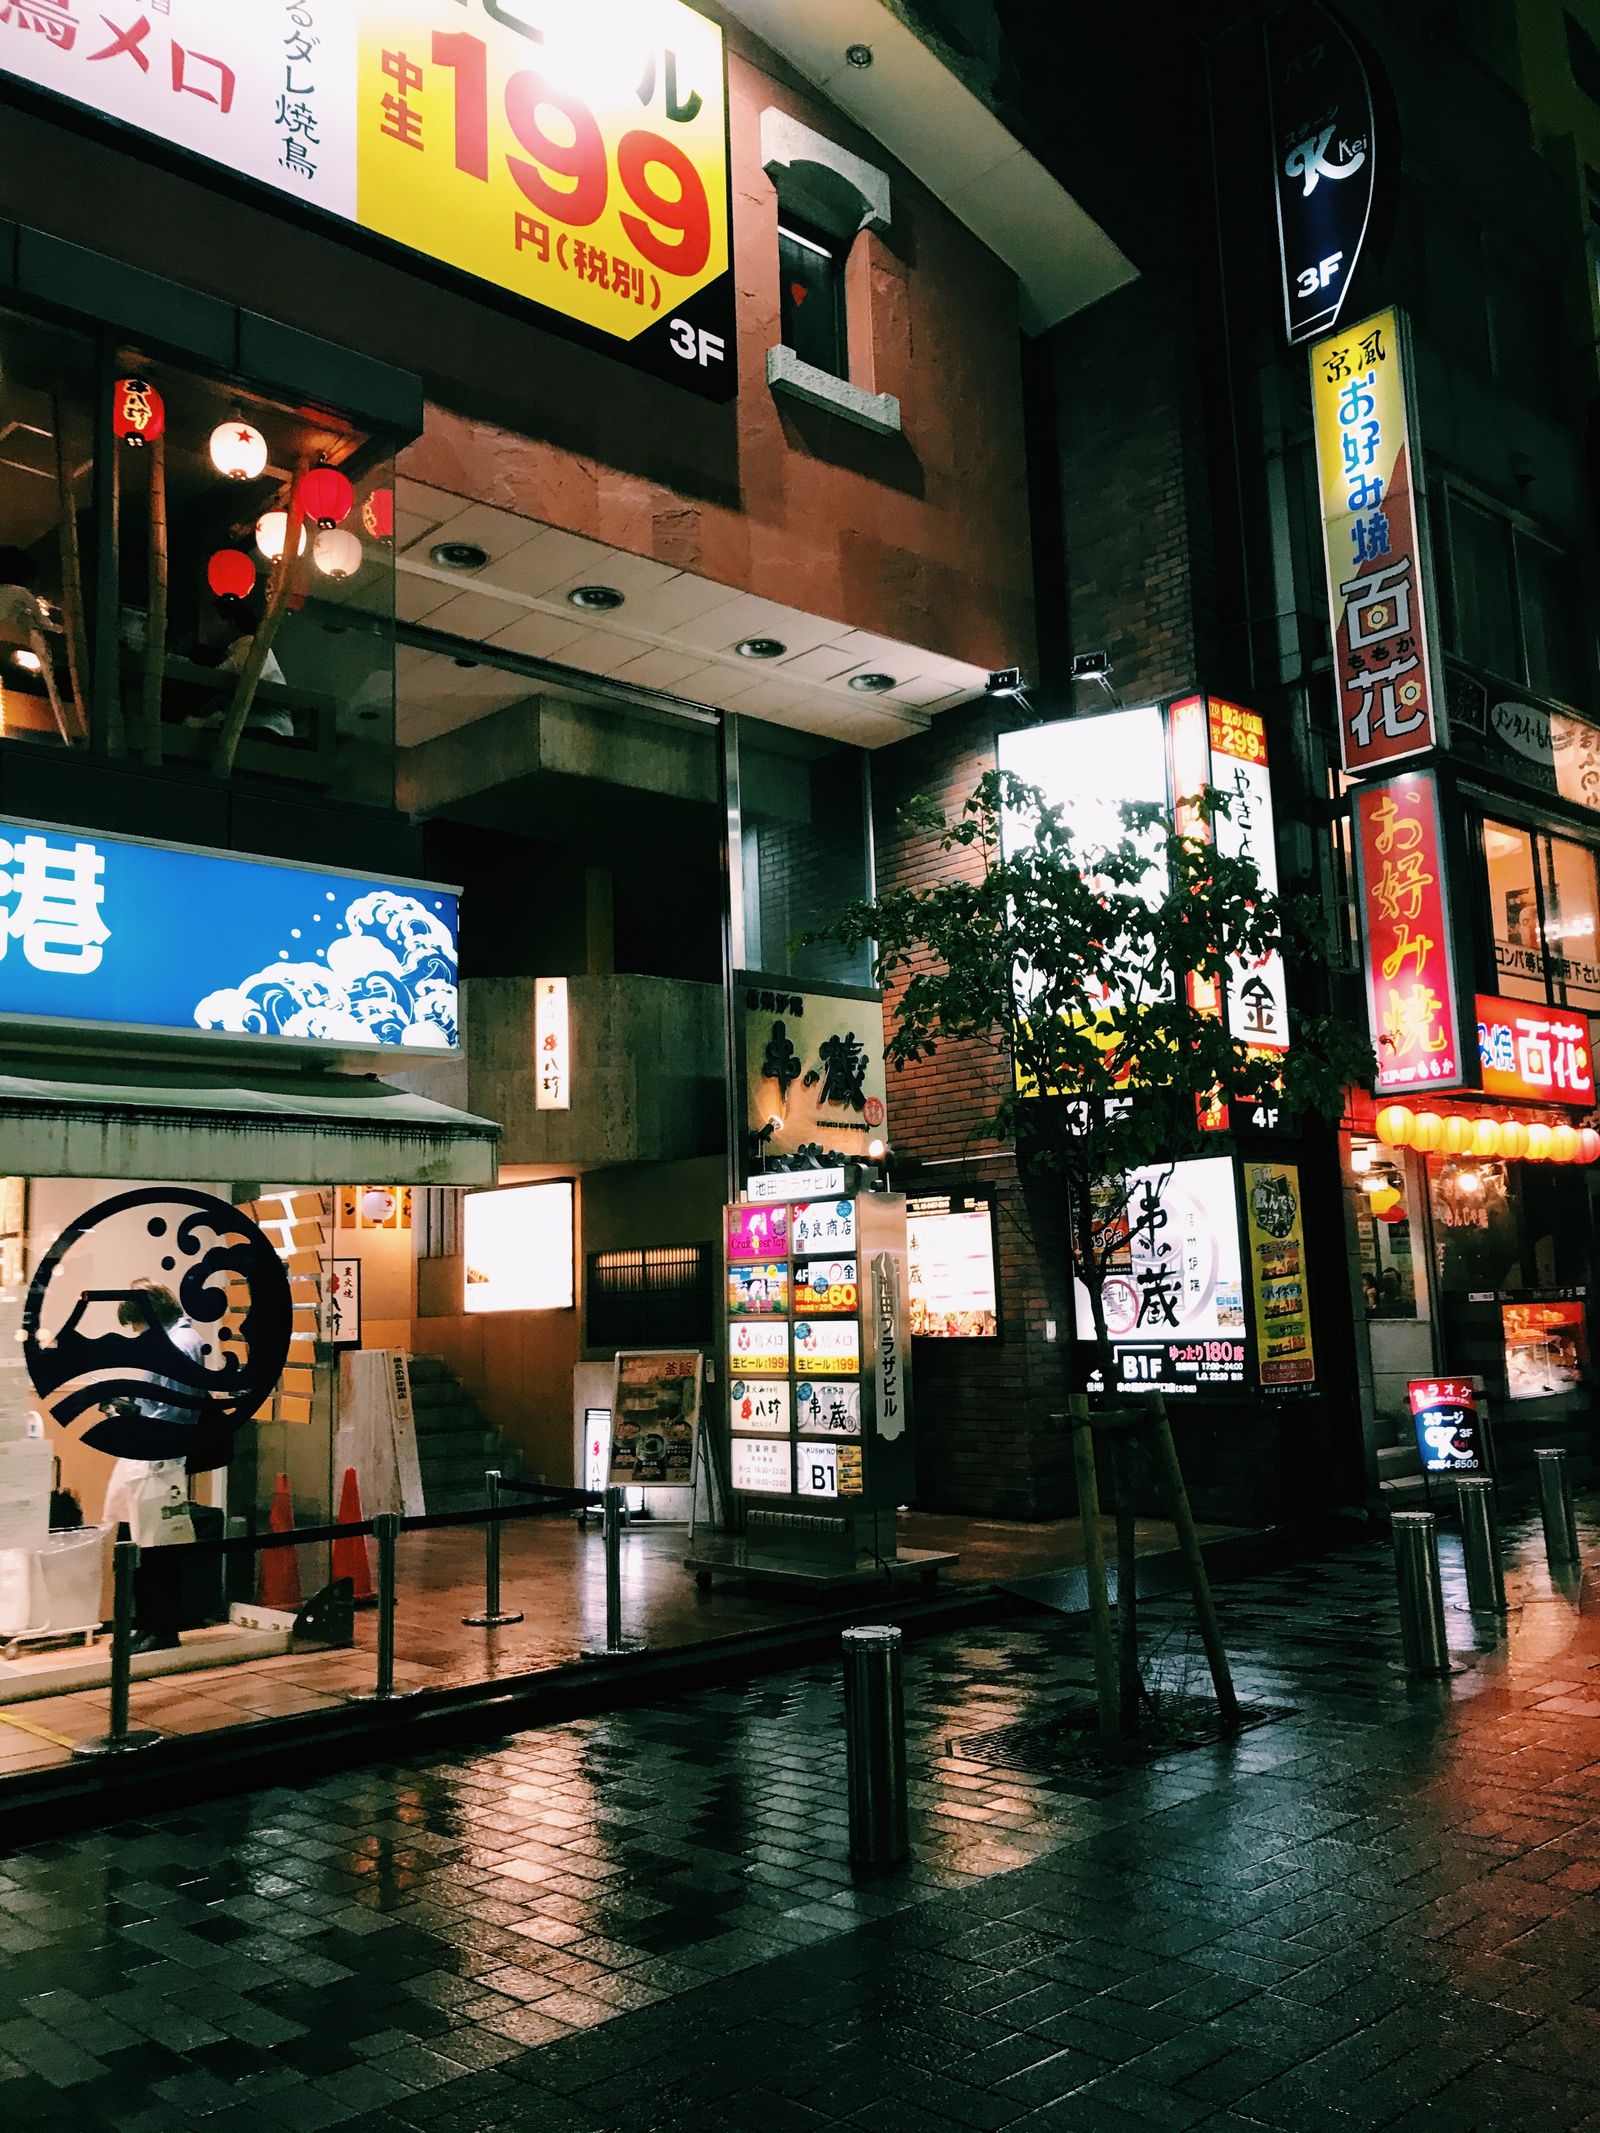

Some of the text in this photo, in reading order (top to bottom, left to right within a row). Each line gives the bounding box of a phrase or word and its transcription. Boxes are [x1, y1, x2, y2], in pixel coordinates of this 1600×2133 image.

[379, 48, 424, 152] 中生
[431, 29, 711, 278] 199
[1338, 134, 1368, 162] Kei
[1296, 250, 1343, 298] 3F
[669, 318, 725, 367] 3F
[1322, 328, 1386, 384] 京風
[1338, 368, 1393, 567] お好み焼
[1340, 555, 1425, 747] 百花
[1347, 636, 1417, 670] ももか
[1232, 766, 1256, 866] やきと
[0, 835, 112, 975] 港
[1370, 792, 1448, 1058] お好み焼
[1495, 946, 1600, 984] コンパ等に用下さい
[1240, 976, 1278, 1035] 金
[1516, 1018, 1590, 1090] 百花
[1252, 1106, 1279, 1129] 4F
[772, 1234, 787, 1248] Tap
[908, 1232, 922, 1284] 串蔵
[796, 1268, 809, 1283] 4F
[843, 1264, 855, 1280] 金
[664, 1361, 693, 1377] 釜飯
[733, 1357, 763, 1370] 生ビール
[798, 1358, 831, 1371] 生ビール
[1122, 1355, 1163, 1380] B1F
[1459, 1428, 1473, 1438] 3F
[811, 1464, 836, 1492] B1
